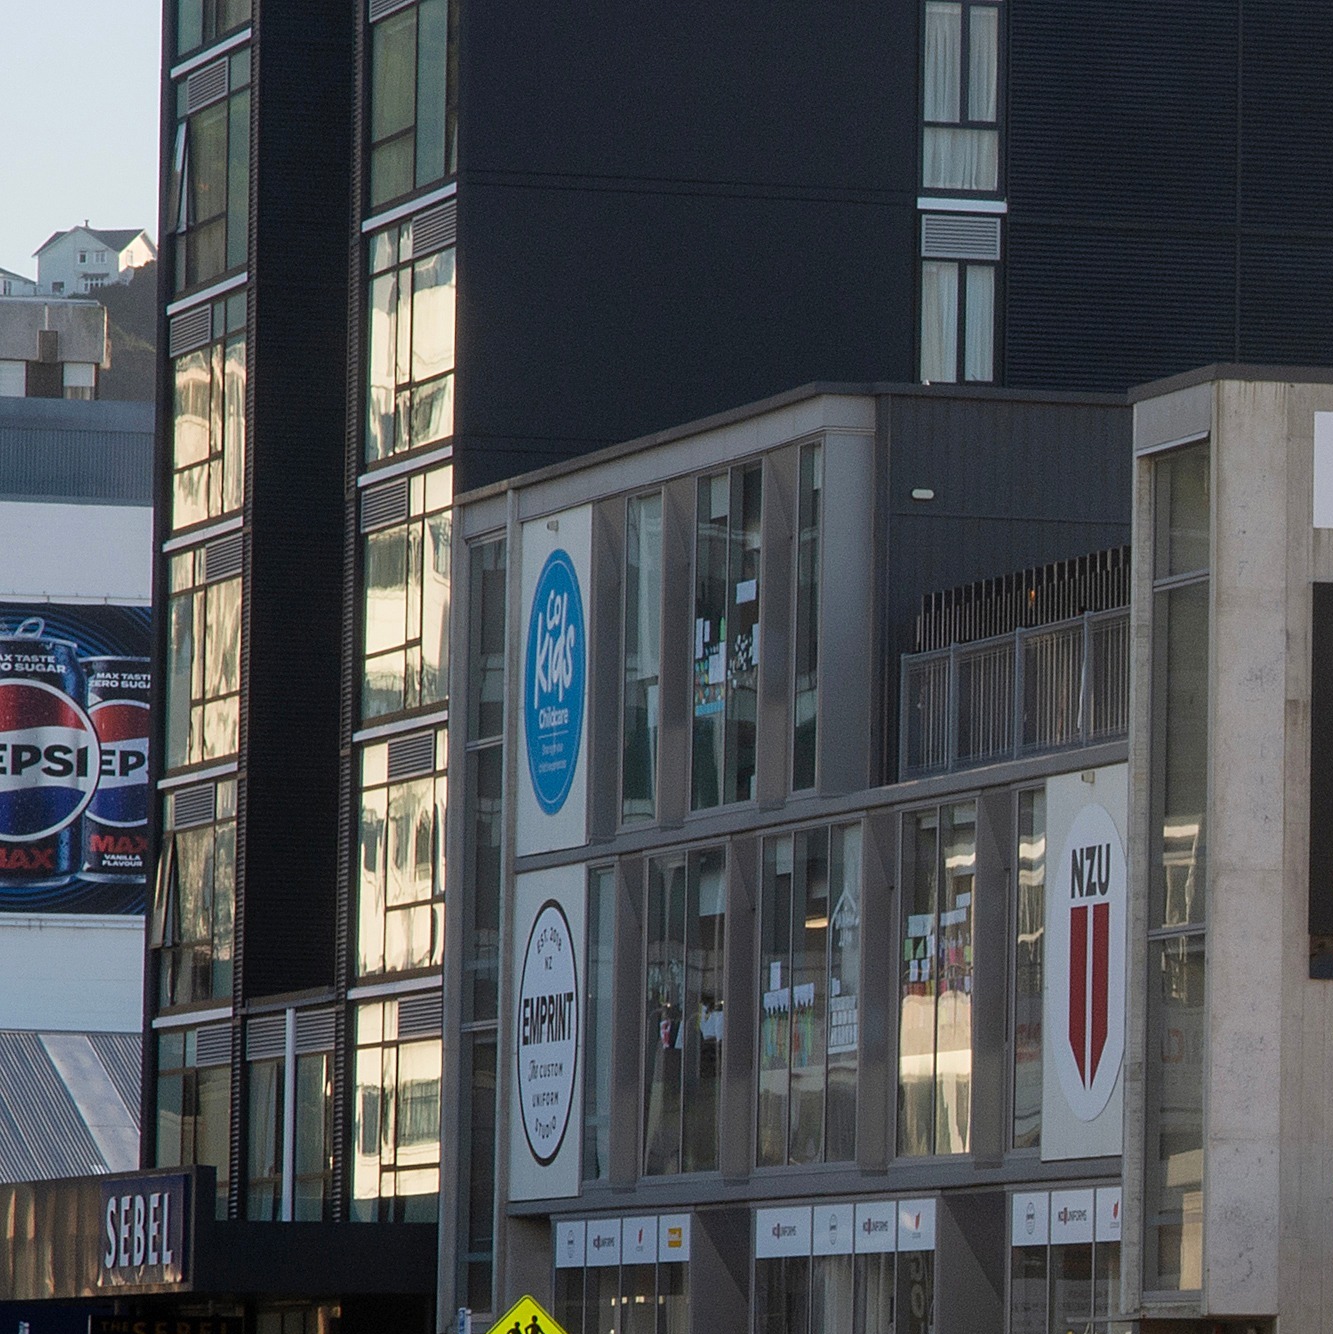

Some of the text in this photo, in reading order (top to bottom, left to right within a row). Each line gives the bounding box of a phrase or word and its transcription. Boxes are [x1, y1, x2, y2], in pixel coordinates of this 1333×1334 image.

[15, 654, 56, 663] TASTE
[15, 662, 66, 674] SUGAR
[97, 672, 119, 680] MAX
[0, 847, 53, 869] AX
[102, 859, 143, 869] FLAVOUR
[104, 853, 141, 862] VANILLA
[1070, 842, 1112, 899] NZU
[522, 991, 574, 1046] EMPRINT
[540, 1062, 563, 1079] CUSTOM
[532, 1091, 560, 1107] UNIFORM
[105, 1192, 174, 1269] SEBEL
